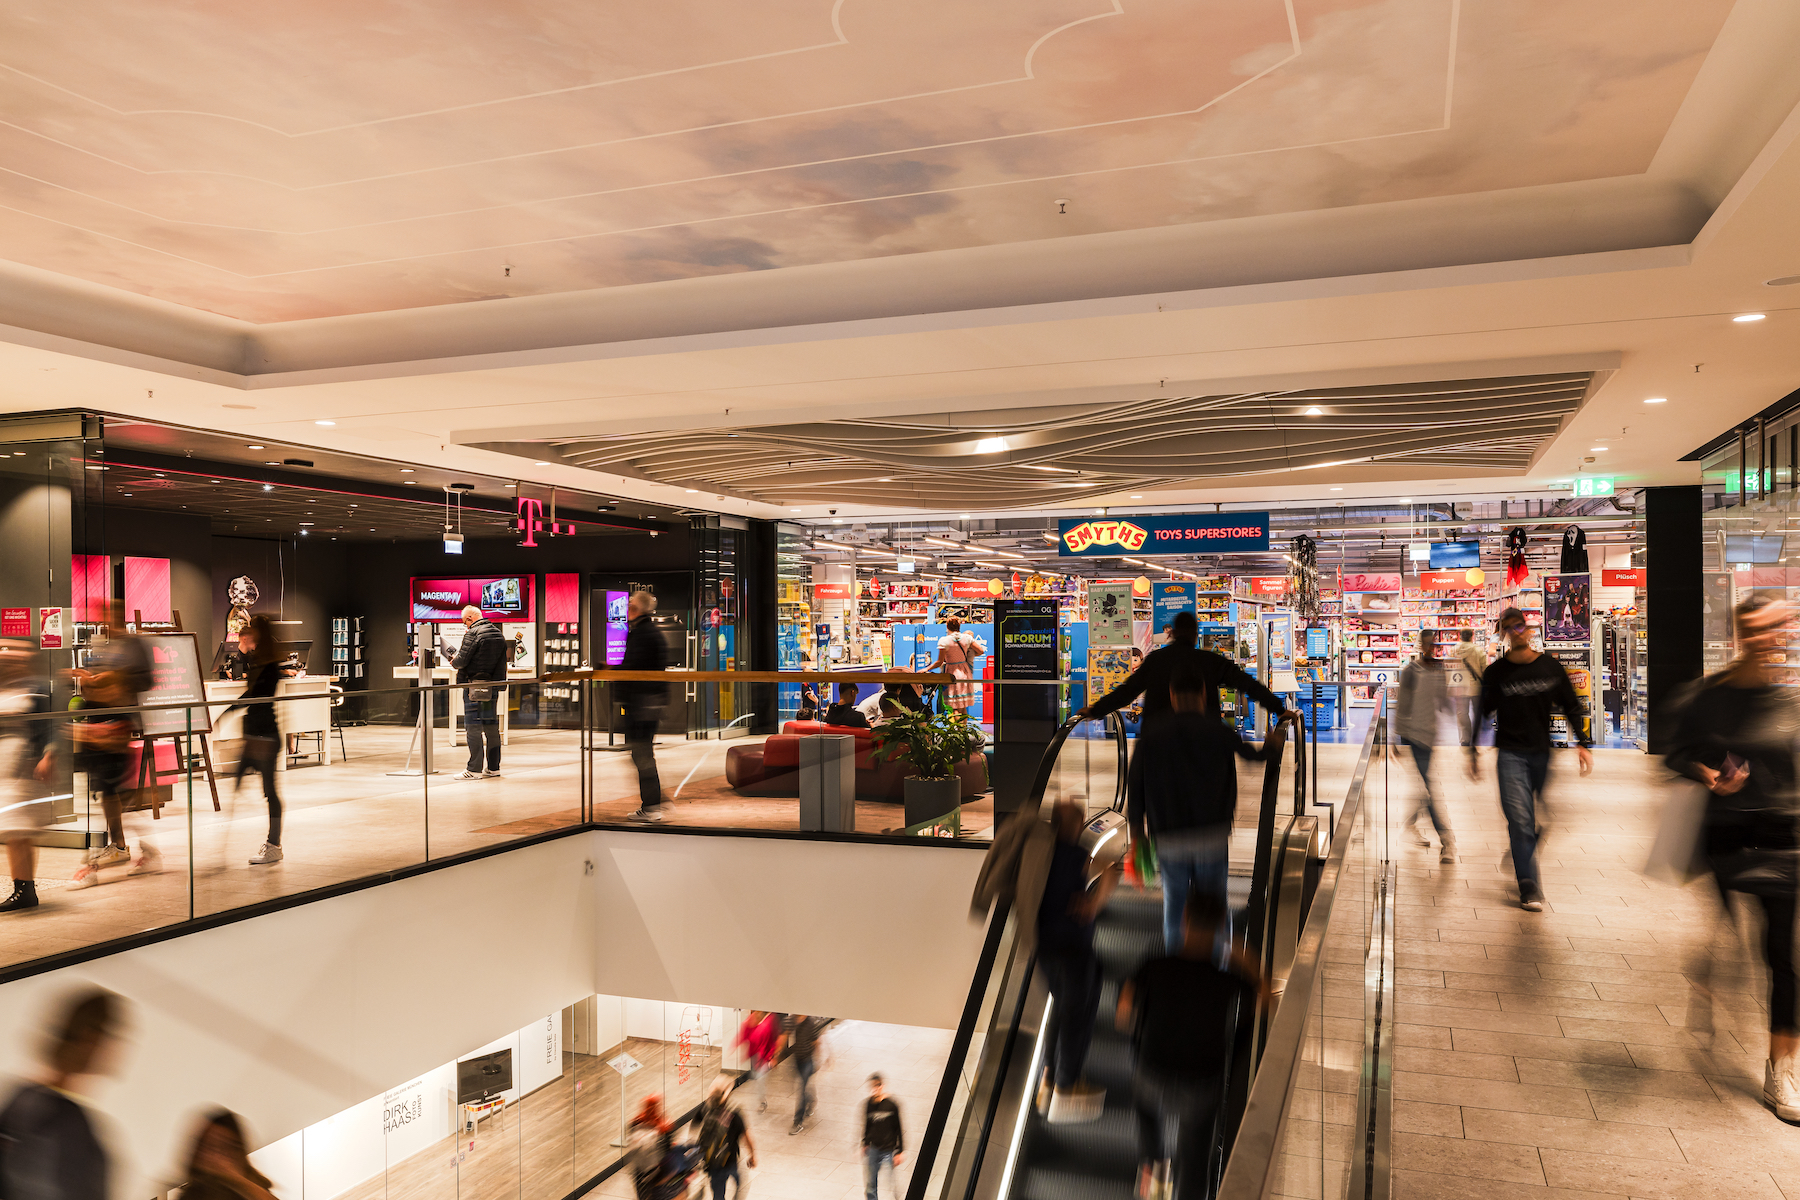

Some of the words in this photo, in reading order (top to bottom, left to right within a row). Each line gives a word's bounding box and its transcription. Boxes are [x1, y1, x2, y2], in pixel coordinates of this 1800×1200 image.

[1067, 526, 1145, 549] SMYTHS
[1154, 529, 1183, 540] TOYS
[1185, 527, 1262, 539] SUPERSTORES
[627, 582, 654, 593] Titan
[1014, 634, 1052, 643] FORUM
[384, 1100, 408, 1122] DIRK
[384, 1112, 411, 1135] HAAS
